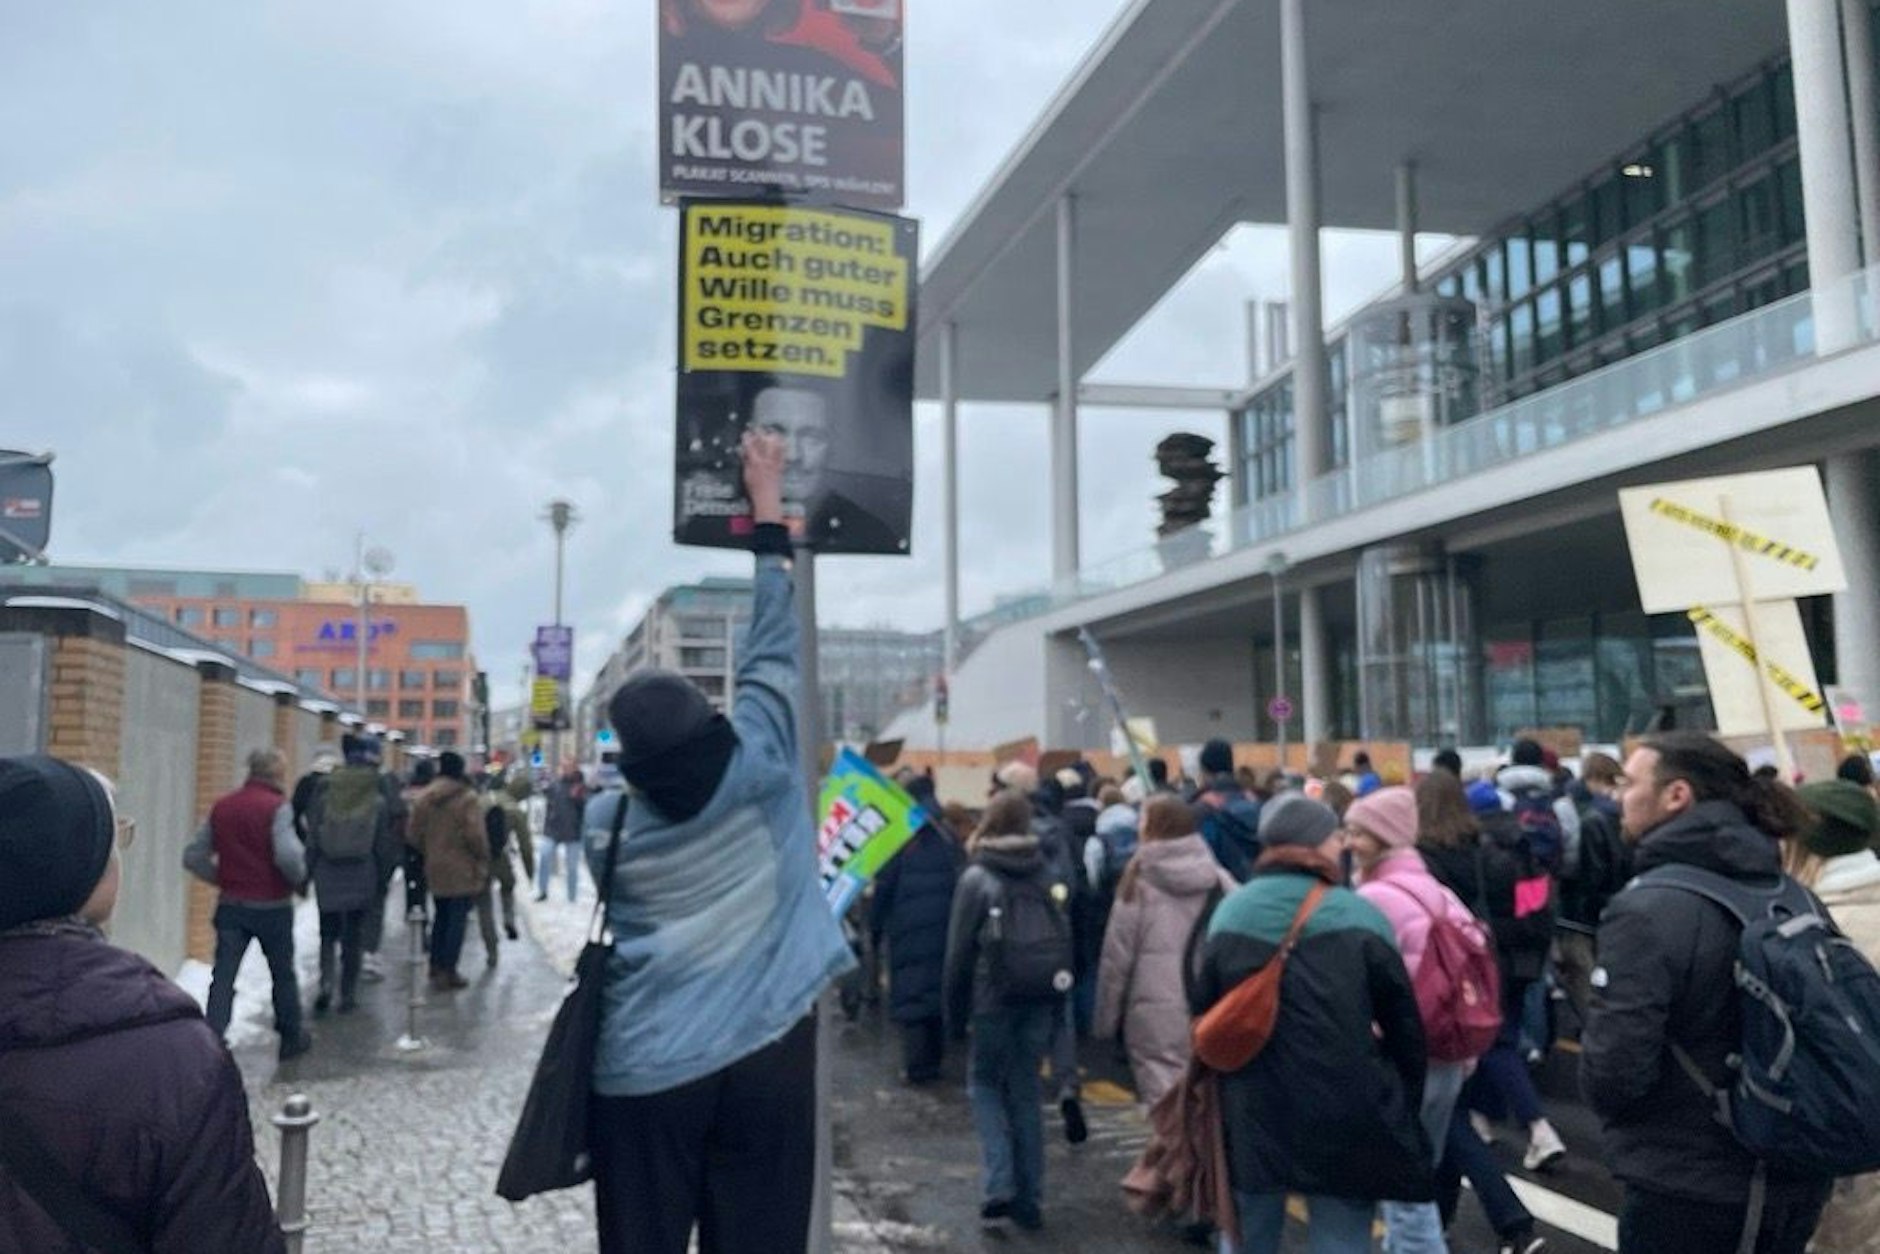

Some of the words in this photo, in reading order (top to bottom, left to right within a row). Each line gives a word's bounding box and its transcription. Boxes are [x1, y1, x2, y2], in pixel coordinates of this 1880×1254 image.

[671, 63, 874, 121] ANNIKA
[671, 114, 828, 166] KLOSE
[699, 216, 885, 255] Migration:
[699, 246, 795, 272] Auch
[803, 256, 897, 286] guter
[699, 276, 792, 302] Wille
[801, 288, 895, 319] muss
[697, 306, 851, 338] Grenzen
[697, 337, 836, 366] setzen.
